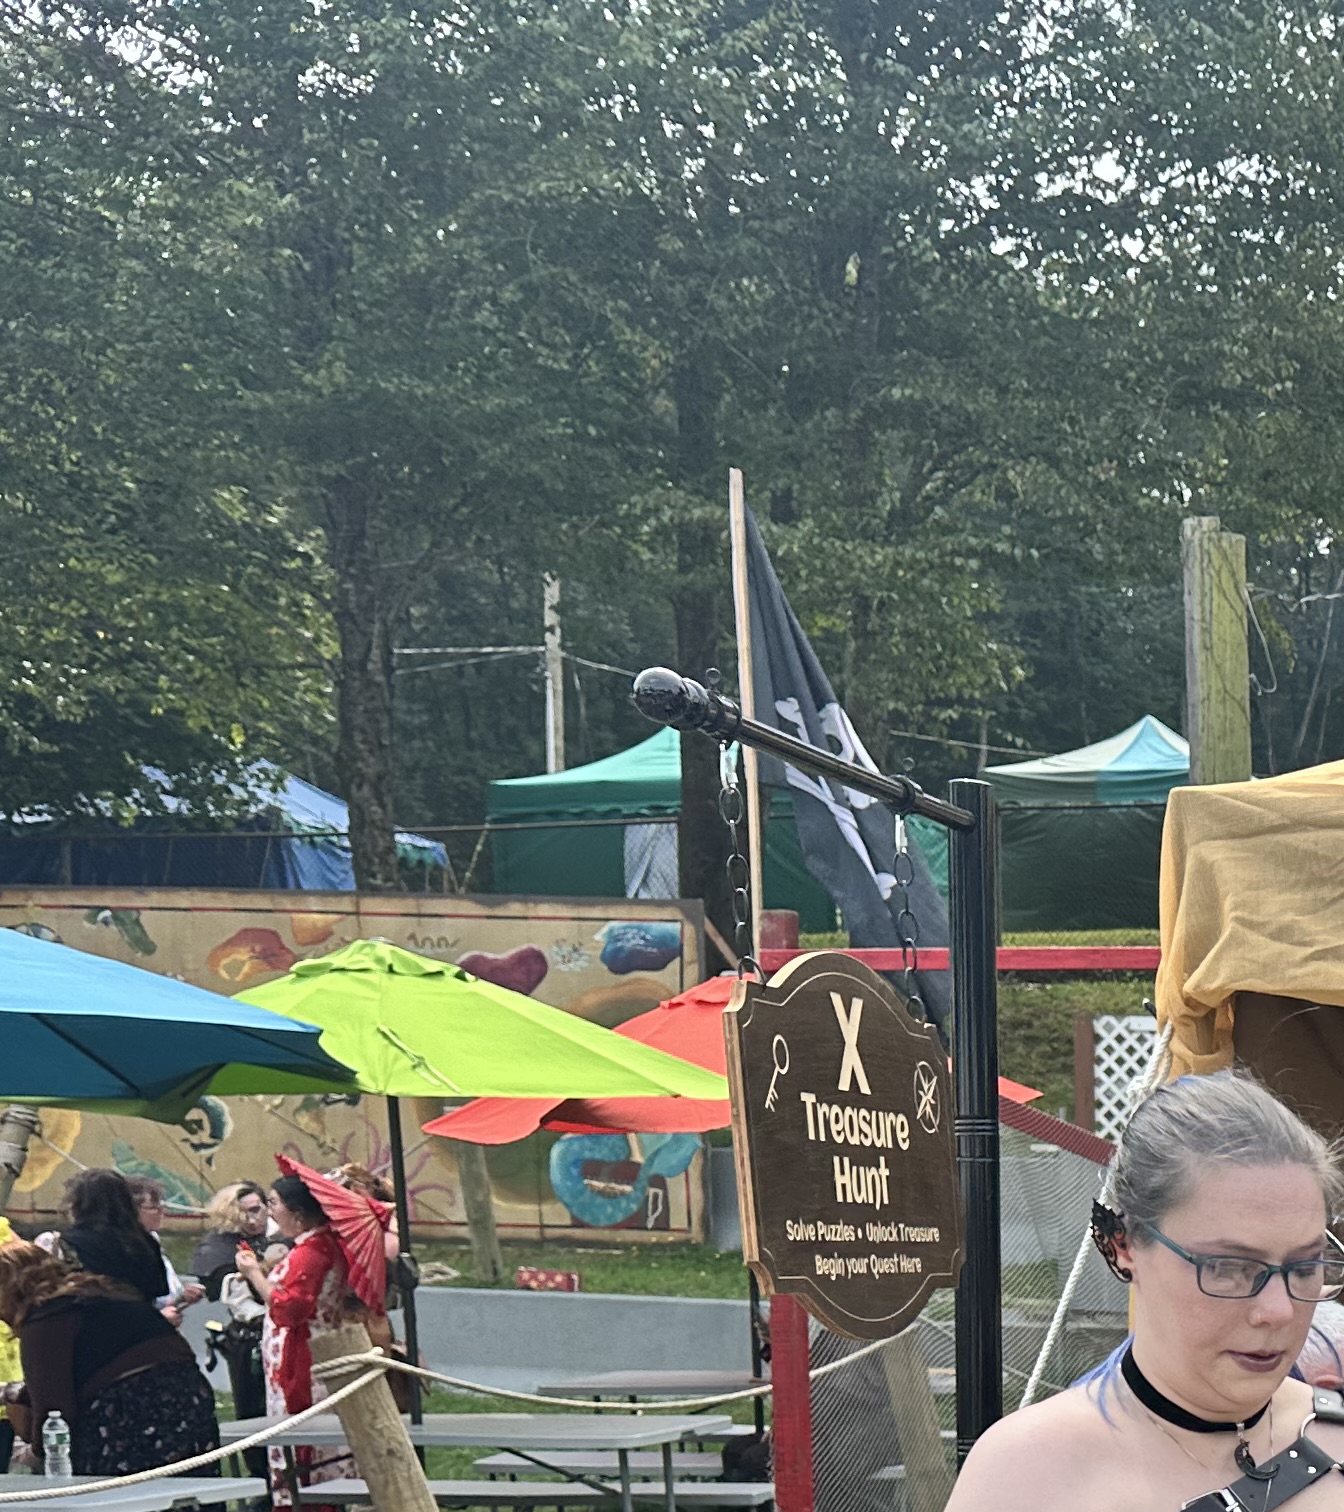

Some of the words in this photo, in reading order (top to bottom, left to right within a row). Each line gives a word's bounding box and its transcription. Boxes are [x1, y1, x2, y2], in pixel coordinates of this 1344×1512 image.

[829, 991, 872, 1095] X
[800, 1092, 910, 1151] Treasure
[833, 1155, 890, 1211] Hunt
[785, 1217, 816, 1242] Solve
[817, 1219, 856, 1242] Puzzles
[865, 1220, 898, 1244] Unlock
[899, 1223, 940, 1243] Treasure
[815, 1252, 845, 1281] Begin
[846, 1257, 868, 1280] your
[870, 1252, 898, 1280] Quest
[900, 1254, 922, 1274] Here
